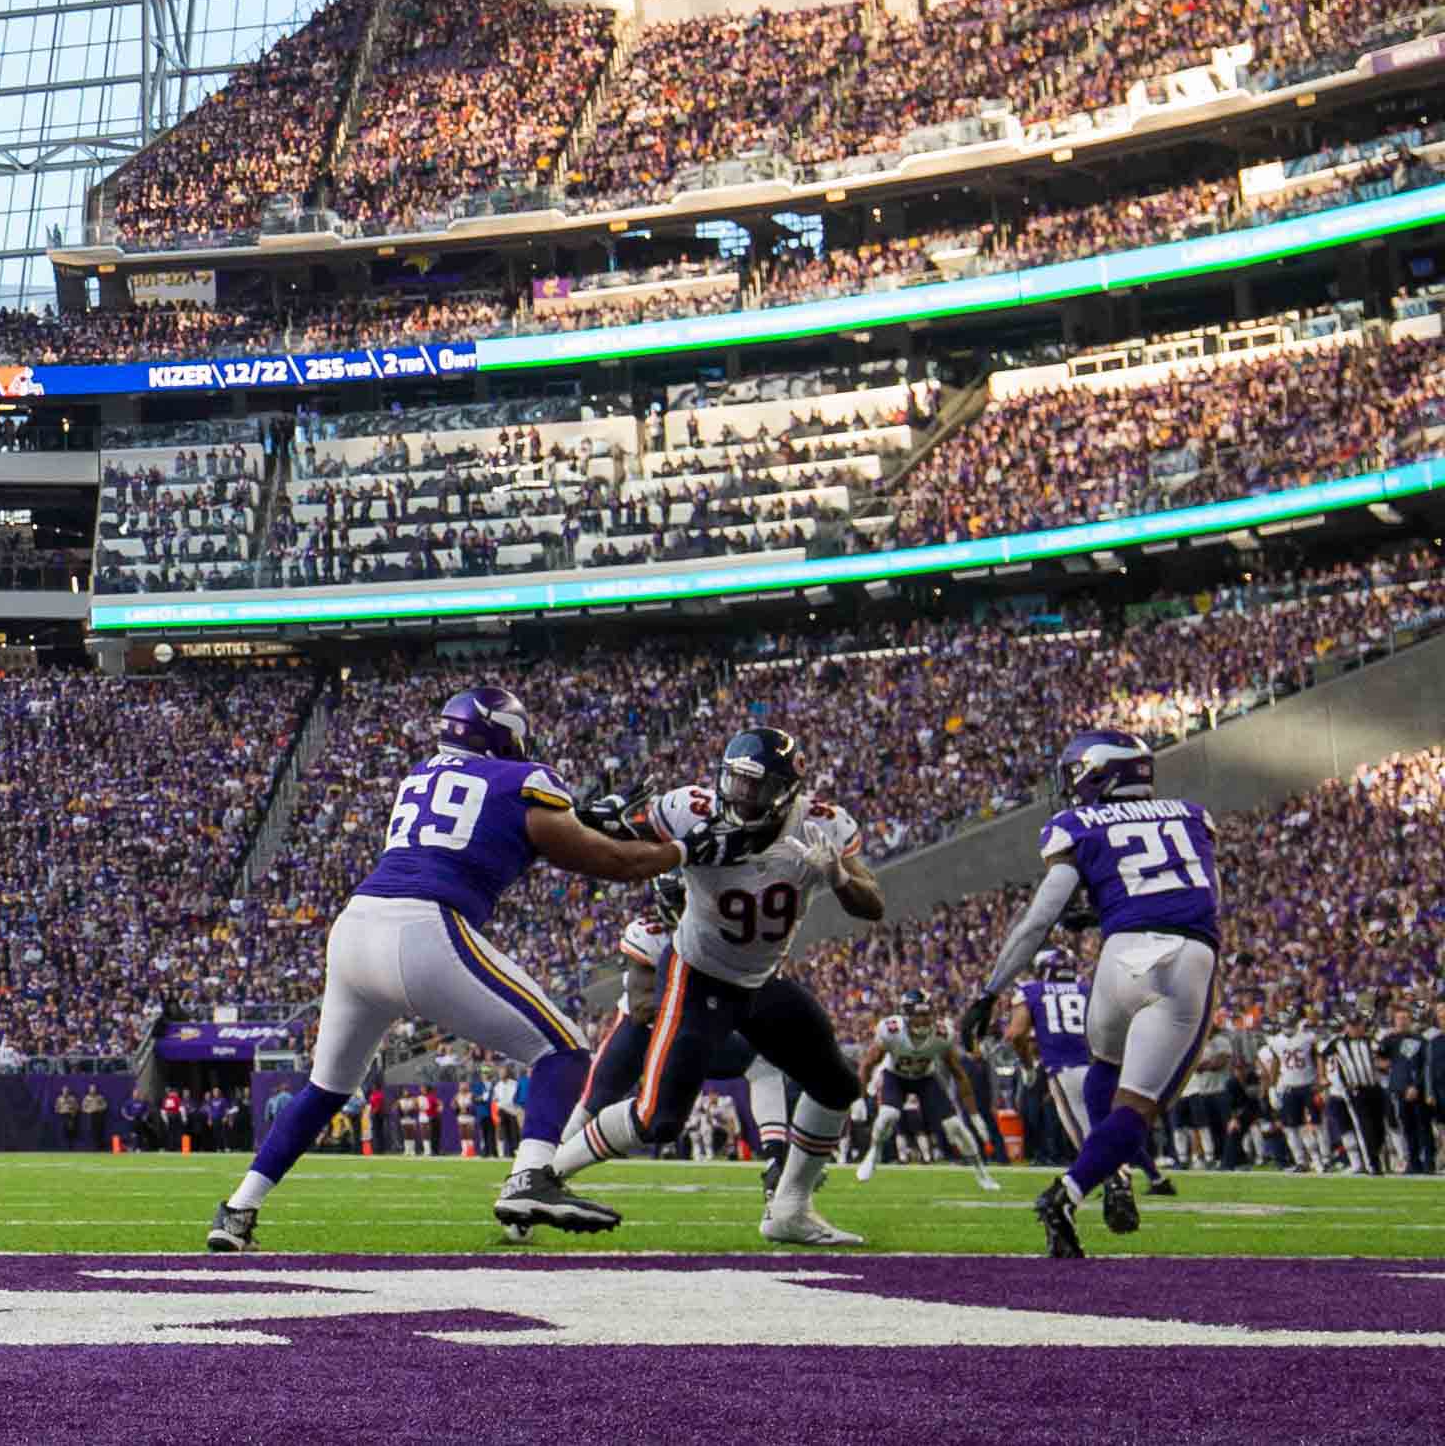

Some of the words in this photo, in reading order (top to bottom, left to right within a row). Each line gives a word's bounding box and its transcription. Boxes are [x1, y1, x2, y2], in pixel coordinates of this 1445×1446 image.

[148, 364, 212, 388] KIZER
[224, 360, 288, 384] 12/22
[383, 770, 488, 851] 69
[1107, 820, 1210, 897] 21
[717, 881, 799, 945] 99
[1041, 993, 1087, 1035] 18
